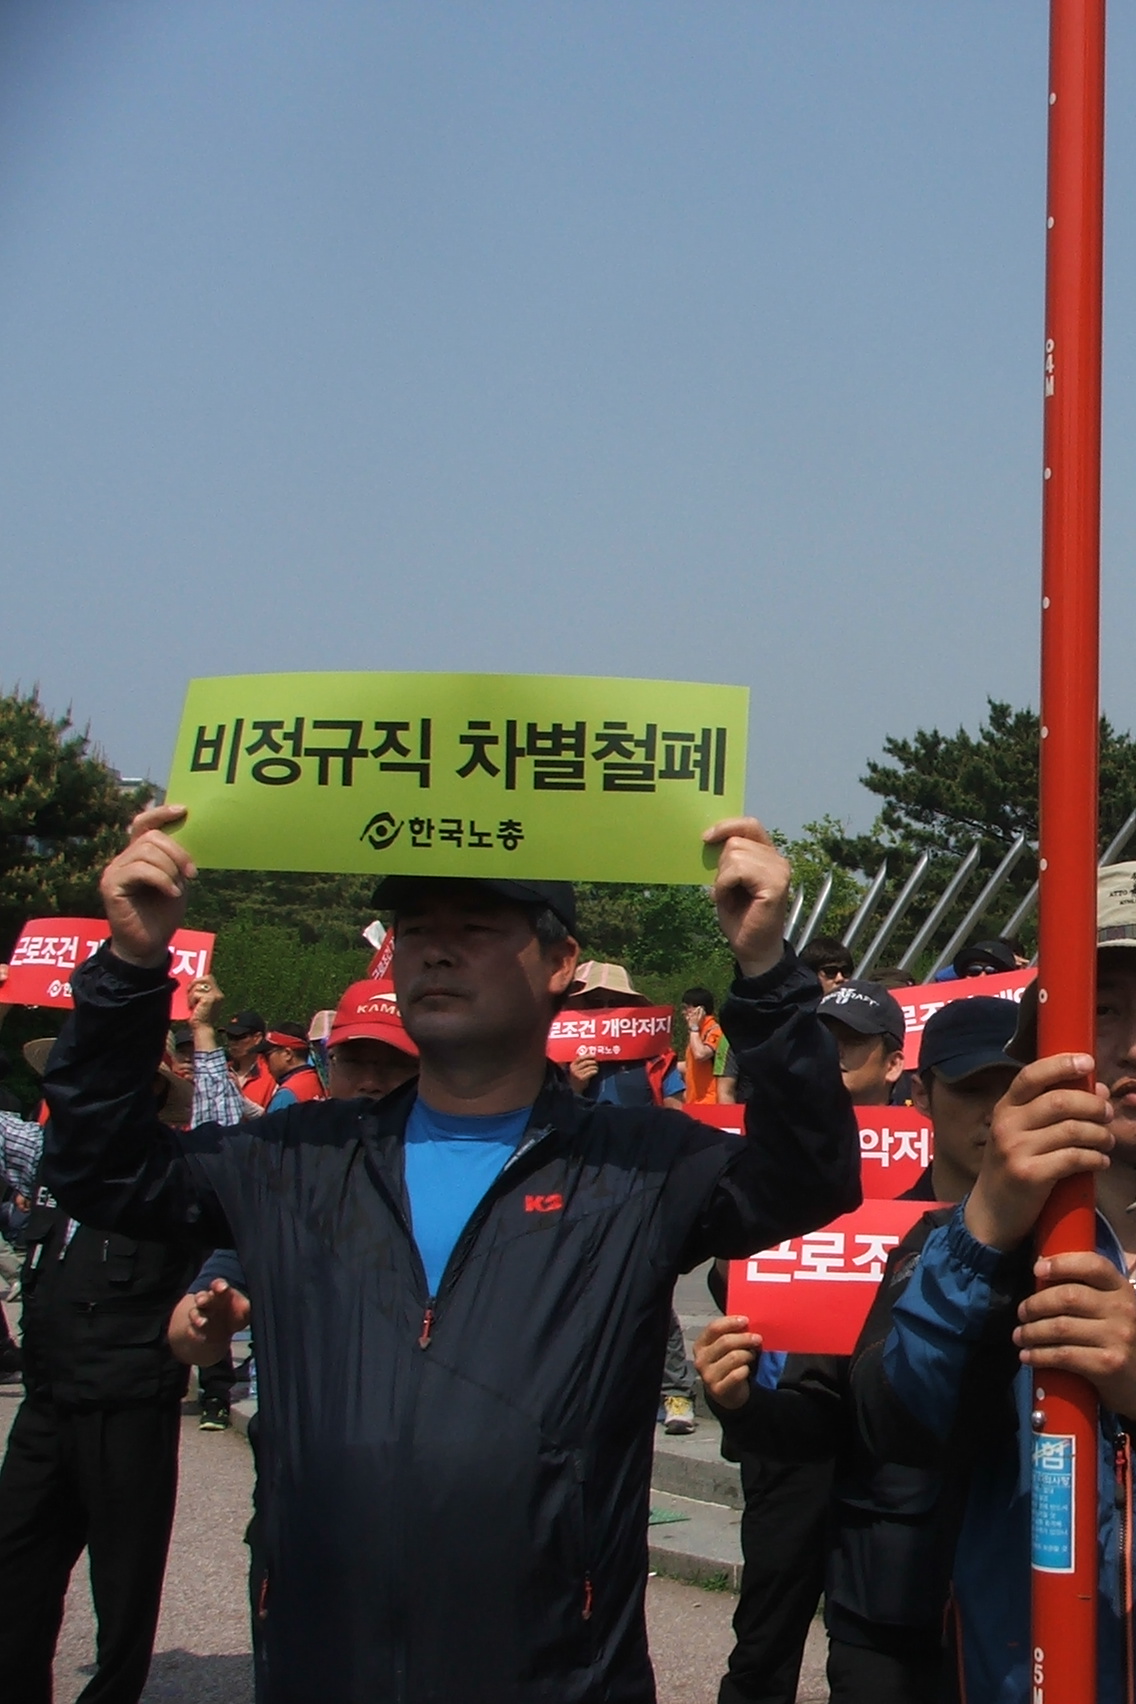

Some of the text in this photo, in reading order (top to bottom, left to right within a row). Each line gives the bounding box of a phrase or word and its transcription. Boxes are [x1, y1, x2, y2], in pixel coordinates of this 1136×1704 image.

[190, 716, 727, 796] 비정규직 차별철폐
[408, 816, 525, 851] 한국노총
[10, 936, 79, 969] 근로조건
[601, 1016, 671, 1038] 개악저지
